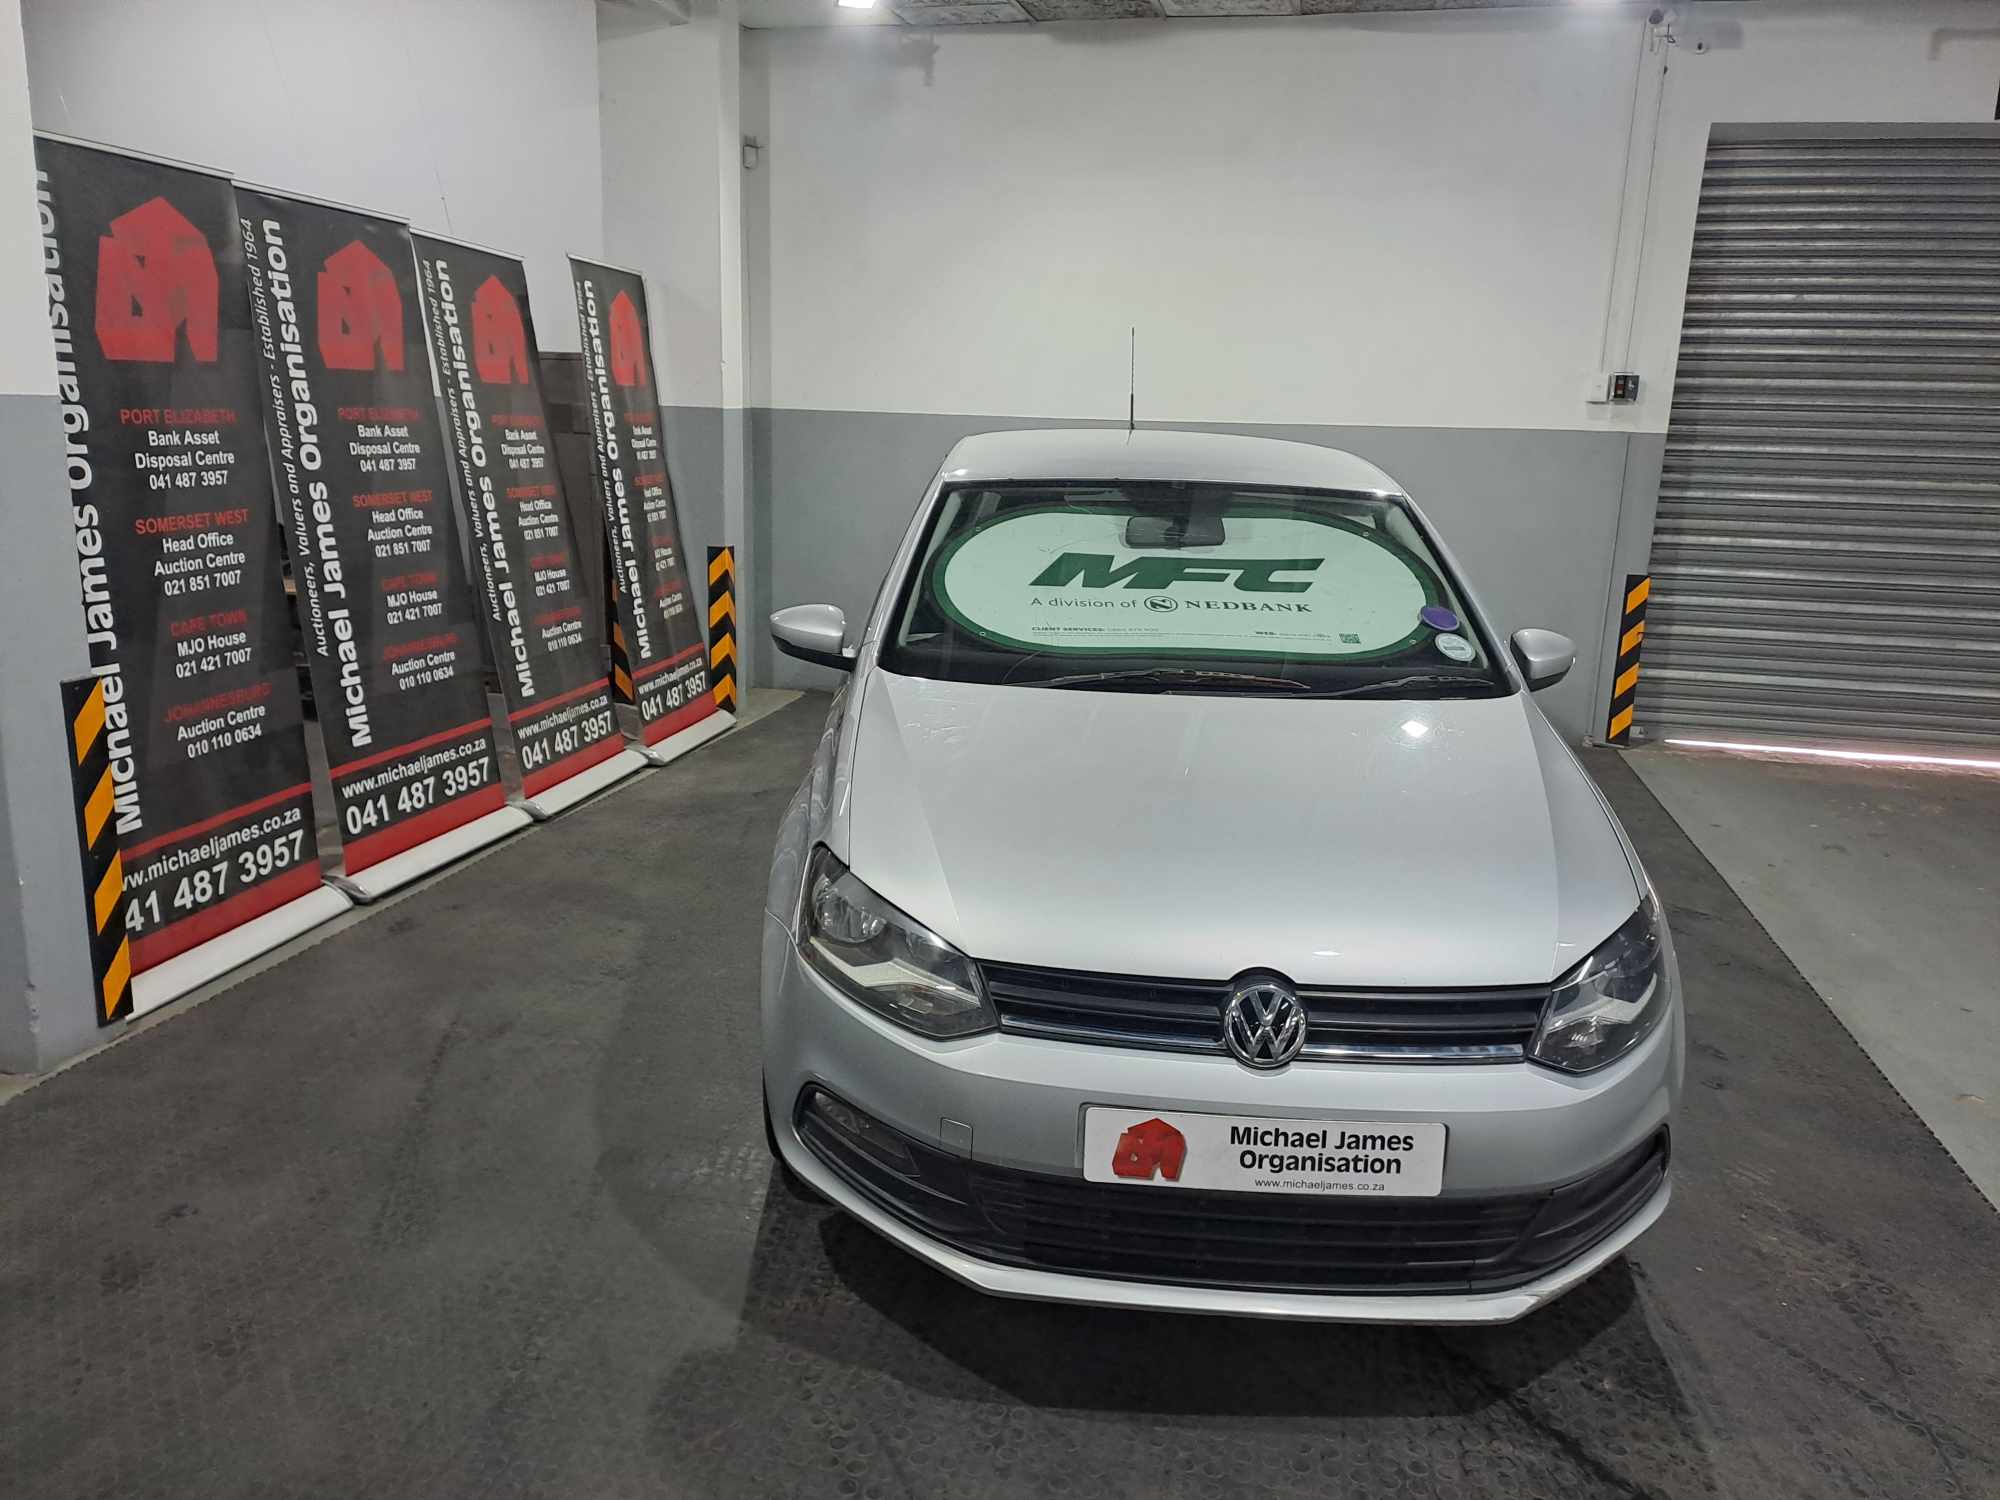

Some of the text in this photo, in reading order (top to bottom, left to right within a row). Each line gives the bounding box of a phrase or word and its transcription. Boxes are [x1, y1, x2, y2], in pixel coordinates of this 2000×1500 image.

[240, 218, 258, 260] 1964
[248, 264, 276, 360] Established
[428, 297, 451, 376] Established
[120, 408, 160, 424] PORT
[268, 374, 294, 459] Appraisers
[448, 388, 468, 458] Appraisers
[148, 430, 220, 446] Bank Asset
[357, 425, 409, 438] Bank Asset
[135, 451, 235, 470] Disposal Centre
[349, 442, 421, 457] Disposal Centre
[149, 470, 228, 489] 041 487 3957
[283, 462, 299, 495] and
[359, 458, 416, 472] 041 487 3957
[436, 260, 536, 698] Michael James Organisation
[460, 460, 473, 487] and
[584, 280, 651, 659] Michael James Organisation
[263, 219, 372, 748] Michael James Organisation
[135, 509, 248, 534] SOMERSET WEST
[291, 497, 310, 556] Valuers
[372, 507, 424, 523] Head Office
[468, 490, 484, 538] Valuers
[162, 532, 234, 553] Head Office
[368, 524, 432, 542] Auction Centre
[375, 539, 431, 558] 021 851 7007
[73, 503, 118, 650] James
[154, 552, 245, 576] Auction Centre
[1028, 552, 1325, 593] MFC
[164, 570, 241, 596] 021 851 7007
[479, 542, 502, 621] Auctioneers,
[304, 562, 328, 656] Auctioneers,
[386, 603, 443, 625] 021 421 7007
[387, 590, 438, 608] MJO House
[1031, 598, 1137, 609] A division of
[1184, 600, 1313, 613] NEDBANK
[177, 632, 246, 657] MJO House
[175, 648, 252, 678] 021 421 7007
[391, 650, 455, 676] Auction Centre
[399, 676, 415, 691] 010
[416, 671, 432, 685] 110
[641, 671, 707, 721] 041 487 3957
[177, 705, 266, 741] Auction Centre
[518, 695, 608, 740] www.michaeljames.co.za
[92, 663, 143, 835] Michael
[187, 723, 262, 758] 010 110 0634
[522, 711, 613, 770] 041 487 3957
[342, 737, 486, 799] www.michaeljames.co.za
[345, 756, 489, 835] 041 487 3957
[123, 807, 301, 891] w.michaeljames.co.za
[125, 829, 304, 932] 41 487 3957
[1229, 1125, 1414, 1151] Michael James
[1239, 1150, 1401, 1175] Organisation
[1255, 1178, 1385, 1192] www.michaeljames.co.za
